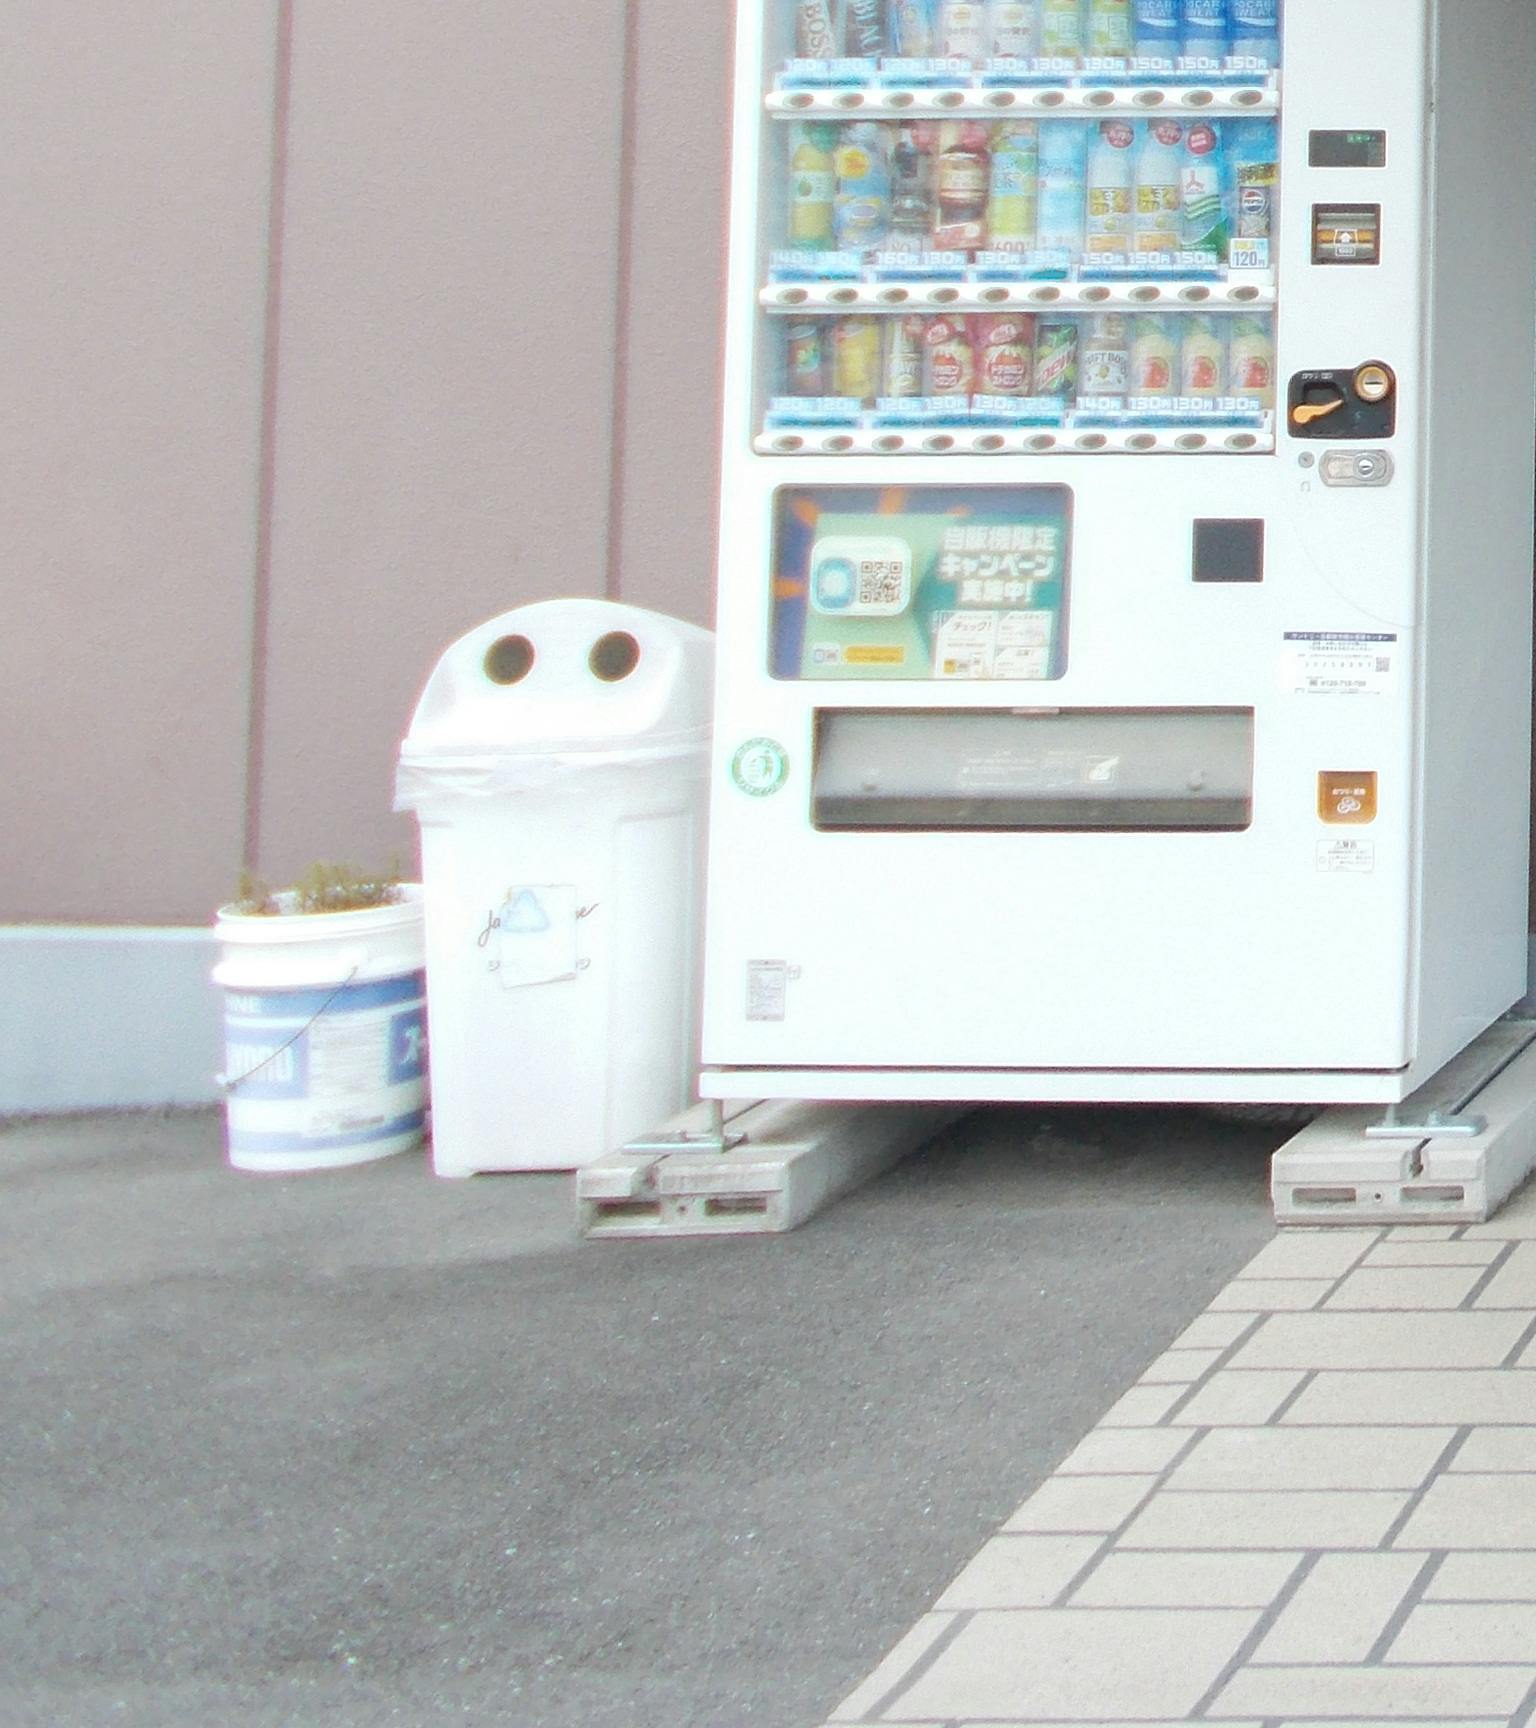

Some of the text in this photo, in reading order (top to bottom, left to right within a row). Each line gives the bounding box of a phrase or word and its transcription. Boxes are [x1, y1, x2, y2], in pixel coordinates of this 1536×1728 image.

[1233, 252, 1266, 267] 120円
[940, 553, 1055, 577] キャンペーン
